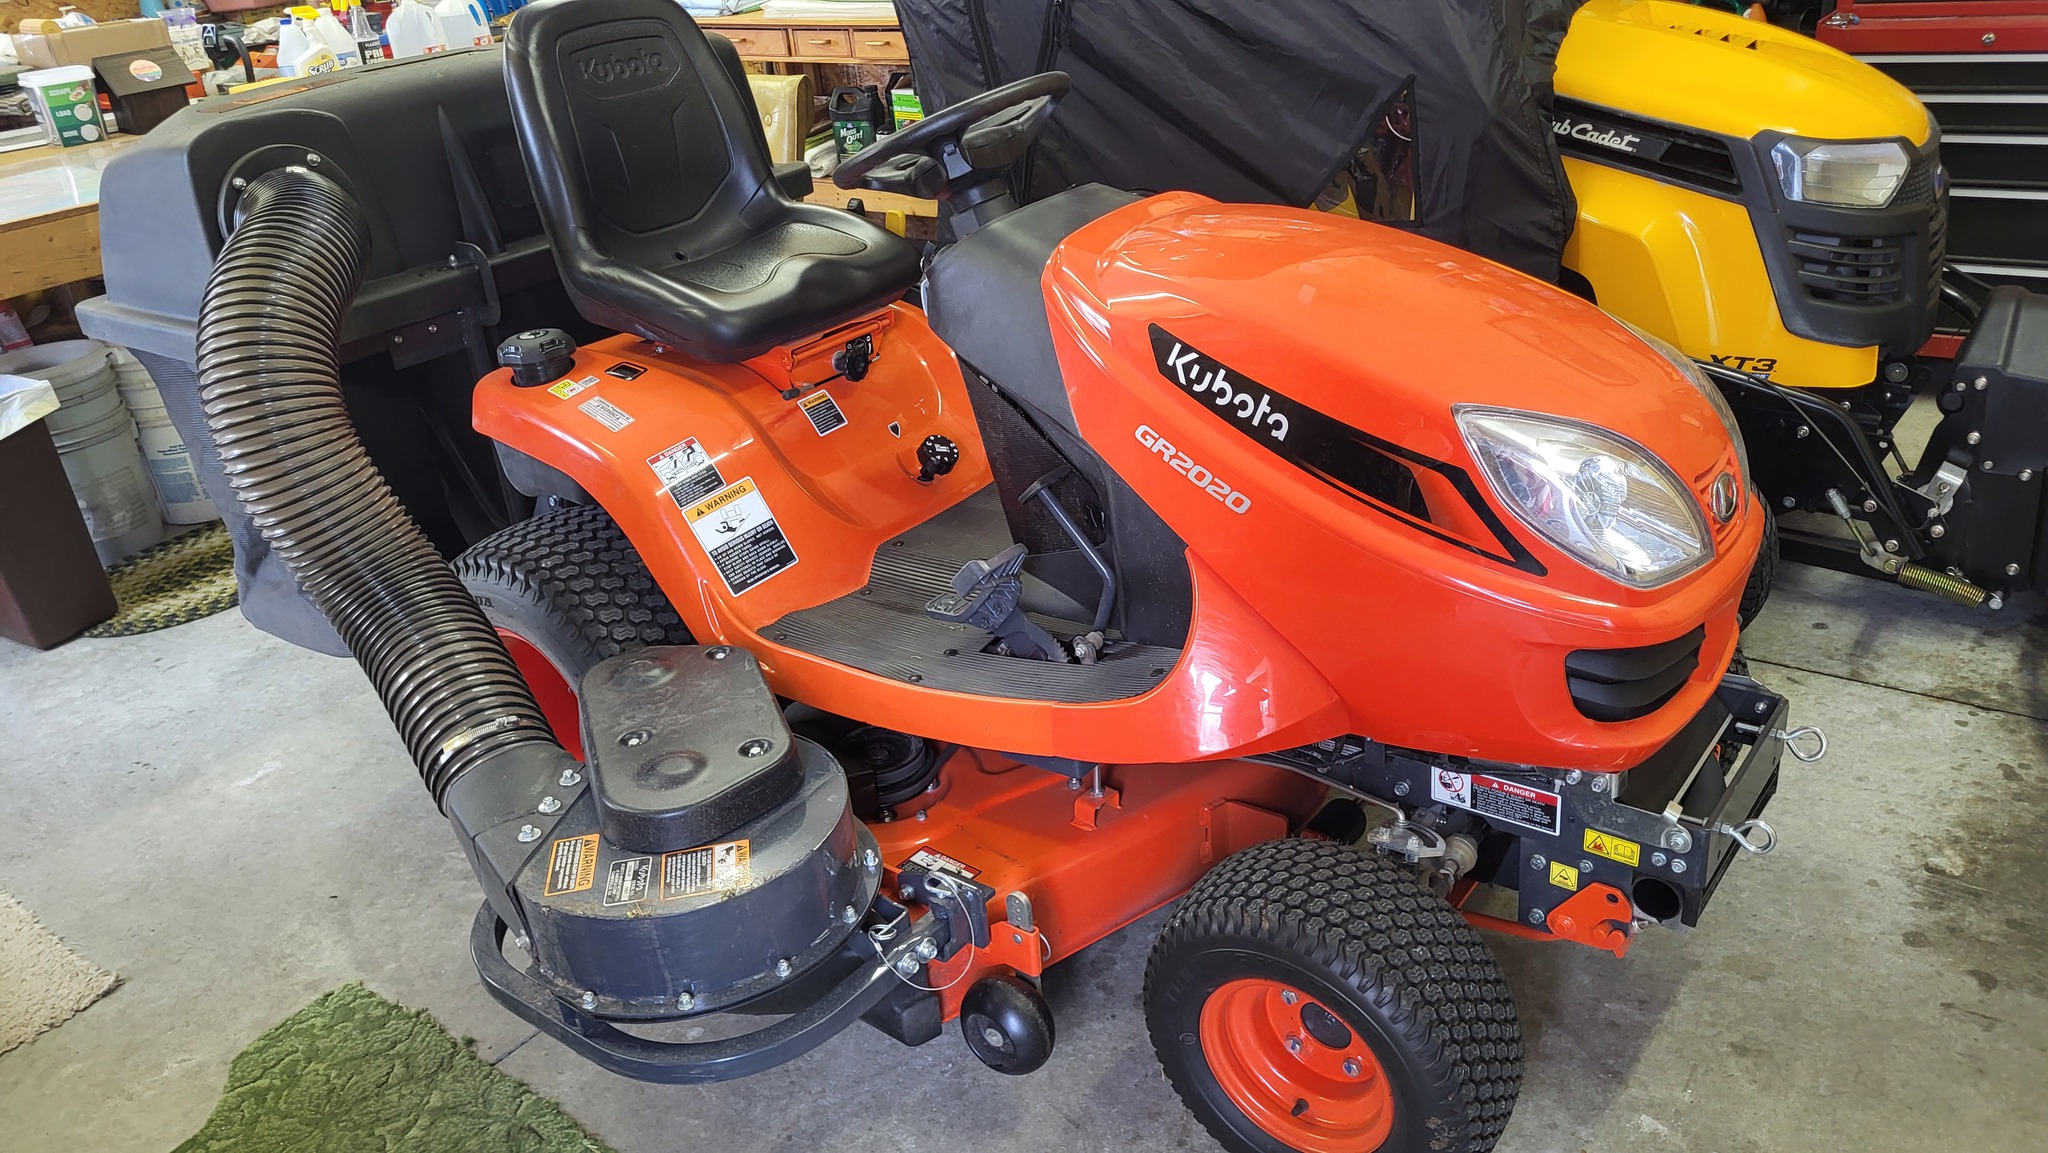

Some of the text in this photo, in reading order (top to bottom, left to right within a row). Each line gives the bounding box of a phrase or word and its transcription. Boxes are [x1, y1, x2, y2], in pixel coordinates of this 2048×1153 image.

[308, 59, 335, 76] SCRUB
[577, 48, 663, 84] Kubota
[1552, 117, 1641, 152] ub Cadet
[1710, 354, 1777, 372] XT3
[1167, 343, 1289, 442] Kubota
[1135, 424, 1251, 514] GR2020
[704, 485, 747, 511] WARNING
[1503, 785, 1536, 798] DANGER
[578, 845, 597, 887] WARNING
[940, 855, 966, 869] DANGER
[636, 864, 649, 891] Kubota
